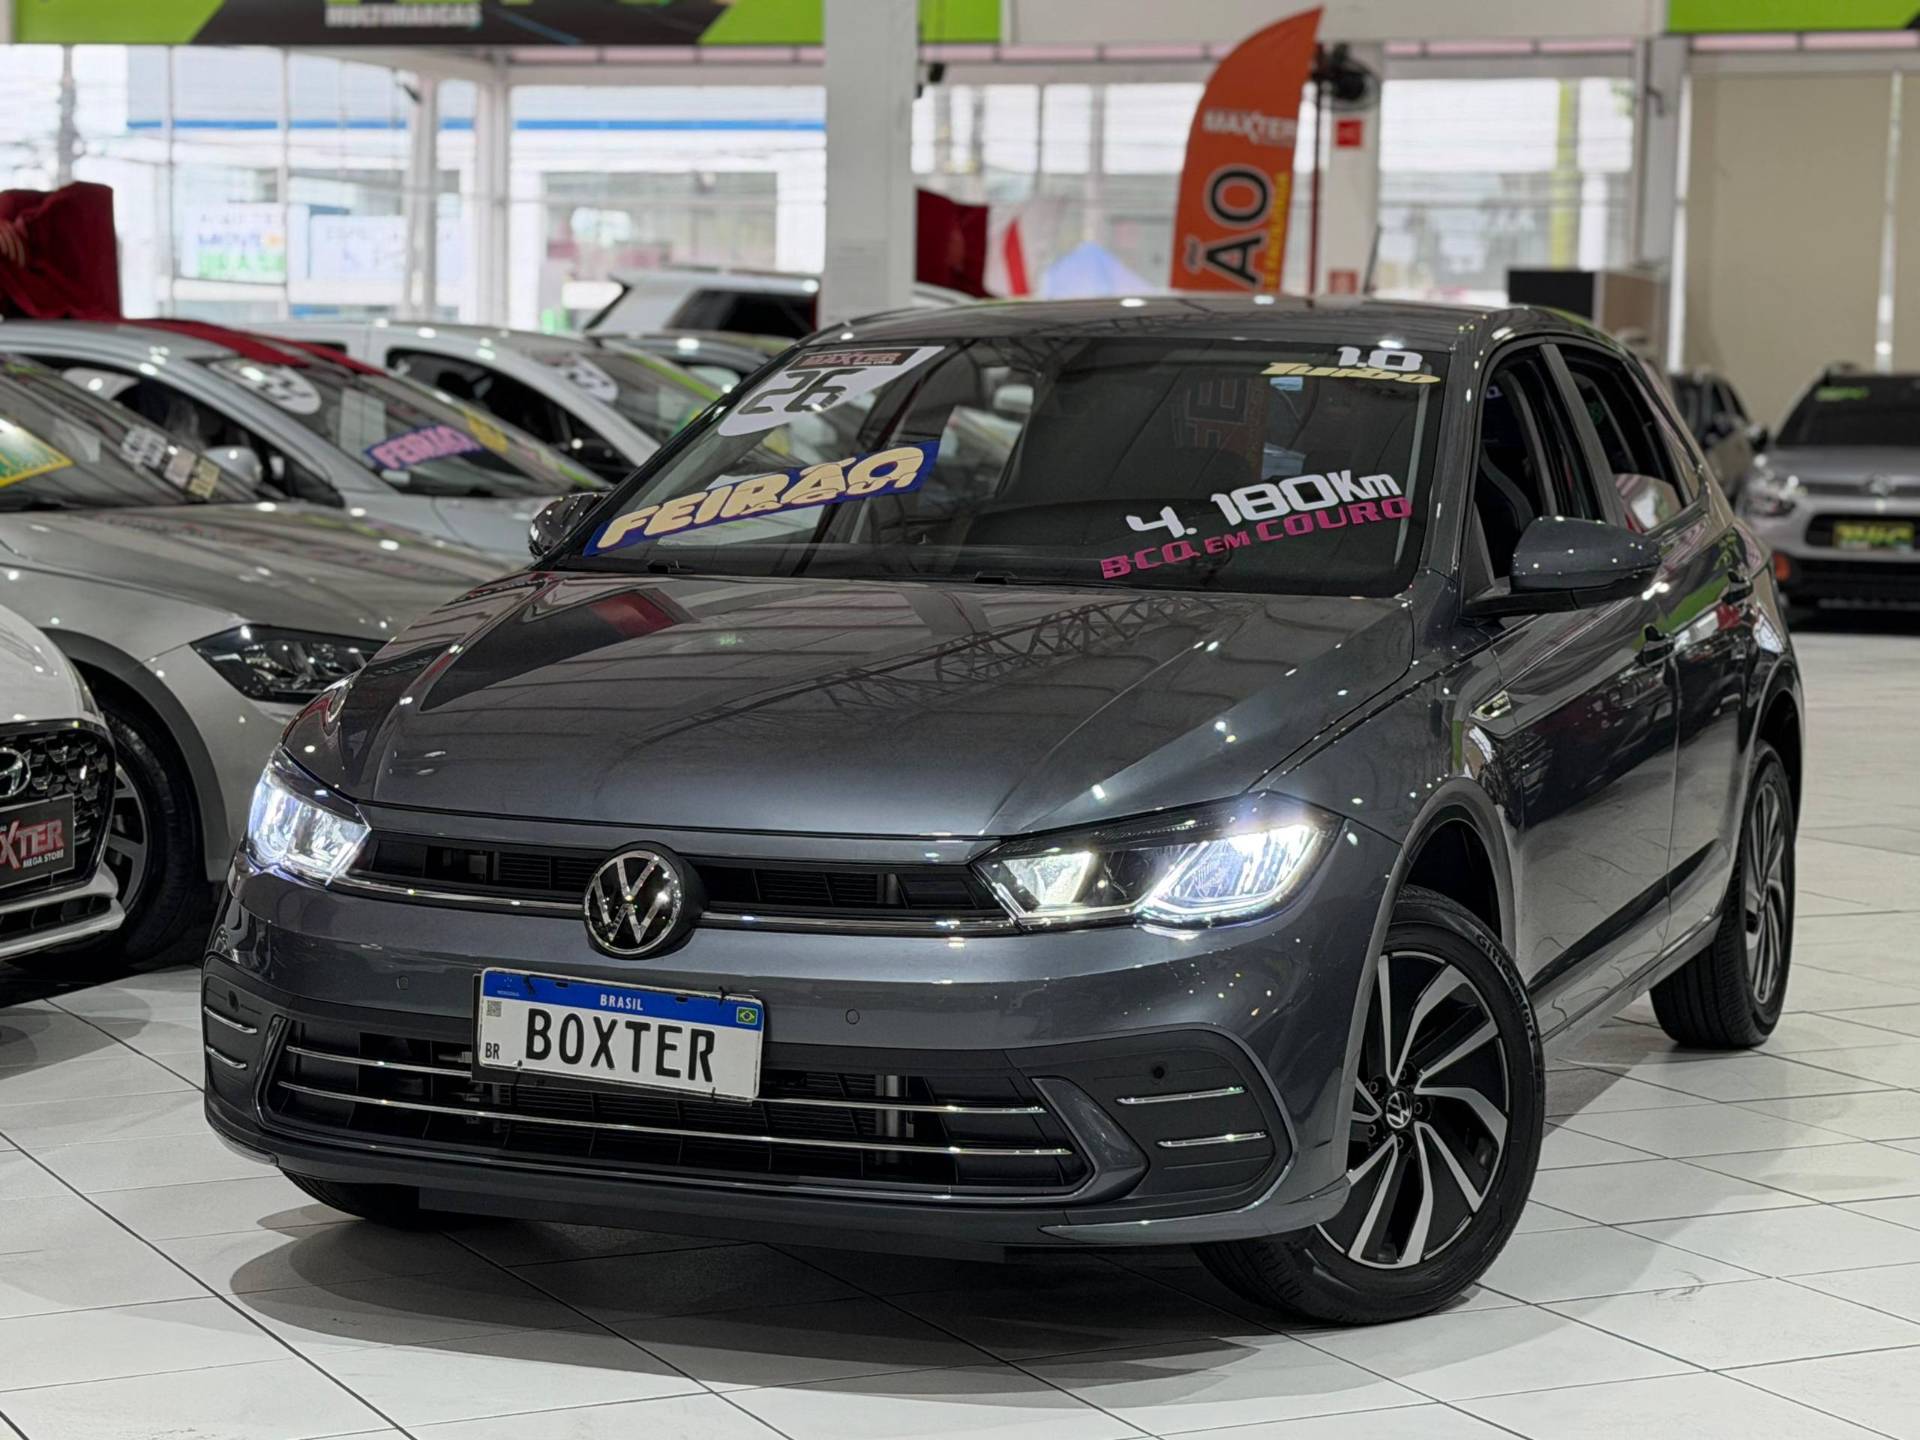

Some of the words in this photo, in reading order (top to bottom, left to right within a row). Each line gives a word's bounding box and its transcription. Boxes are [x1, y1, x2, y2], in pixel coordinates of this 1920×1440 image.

[1337, 346, 1423, 371] 1.0
[737, 367, 868, 415] 26
[596, 446, 925, 549] FEIRÃO
[1204, 530, 1251, 556] EM
[1256, 496, 1414, 543] COURO
[599, 993, 644, 1012] BRASIL
[484, 1042, 501, 1061] BR
[525, 1007, 716, 1083] BOXTER
